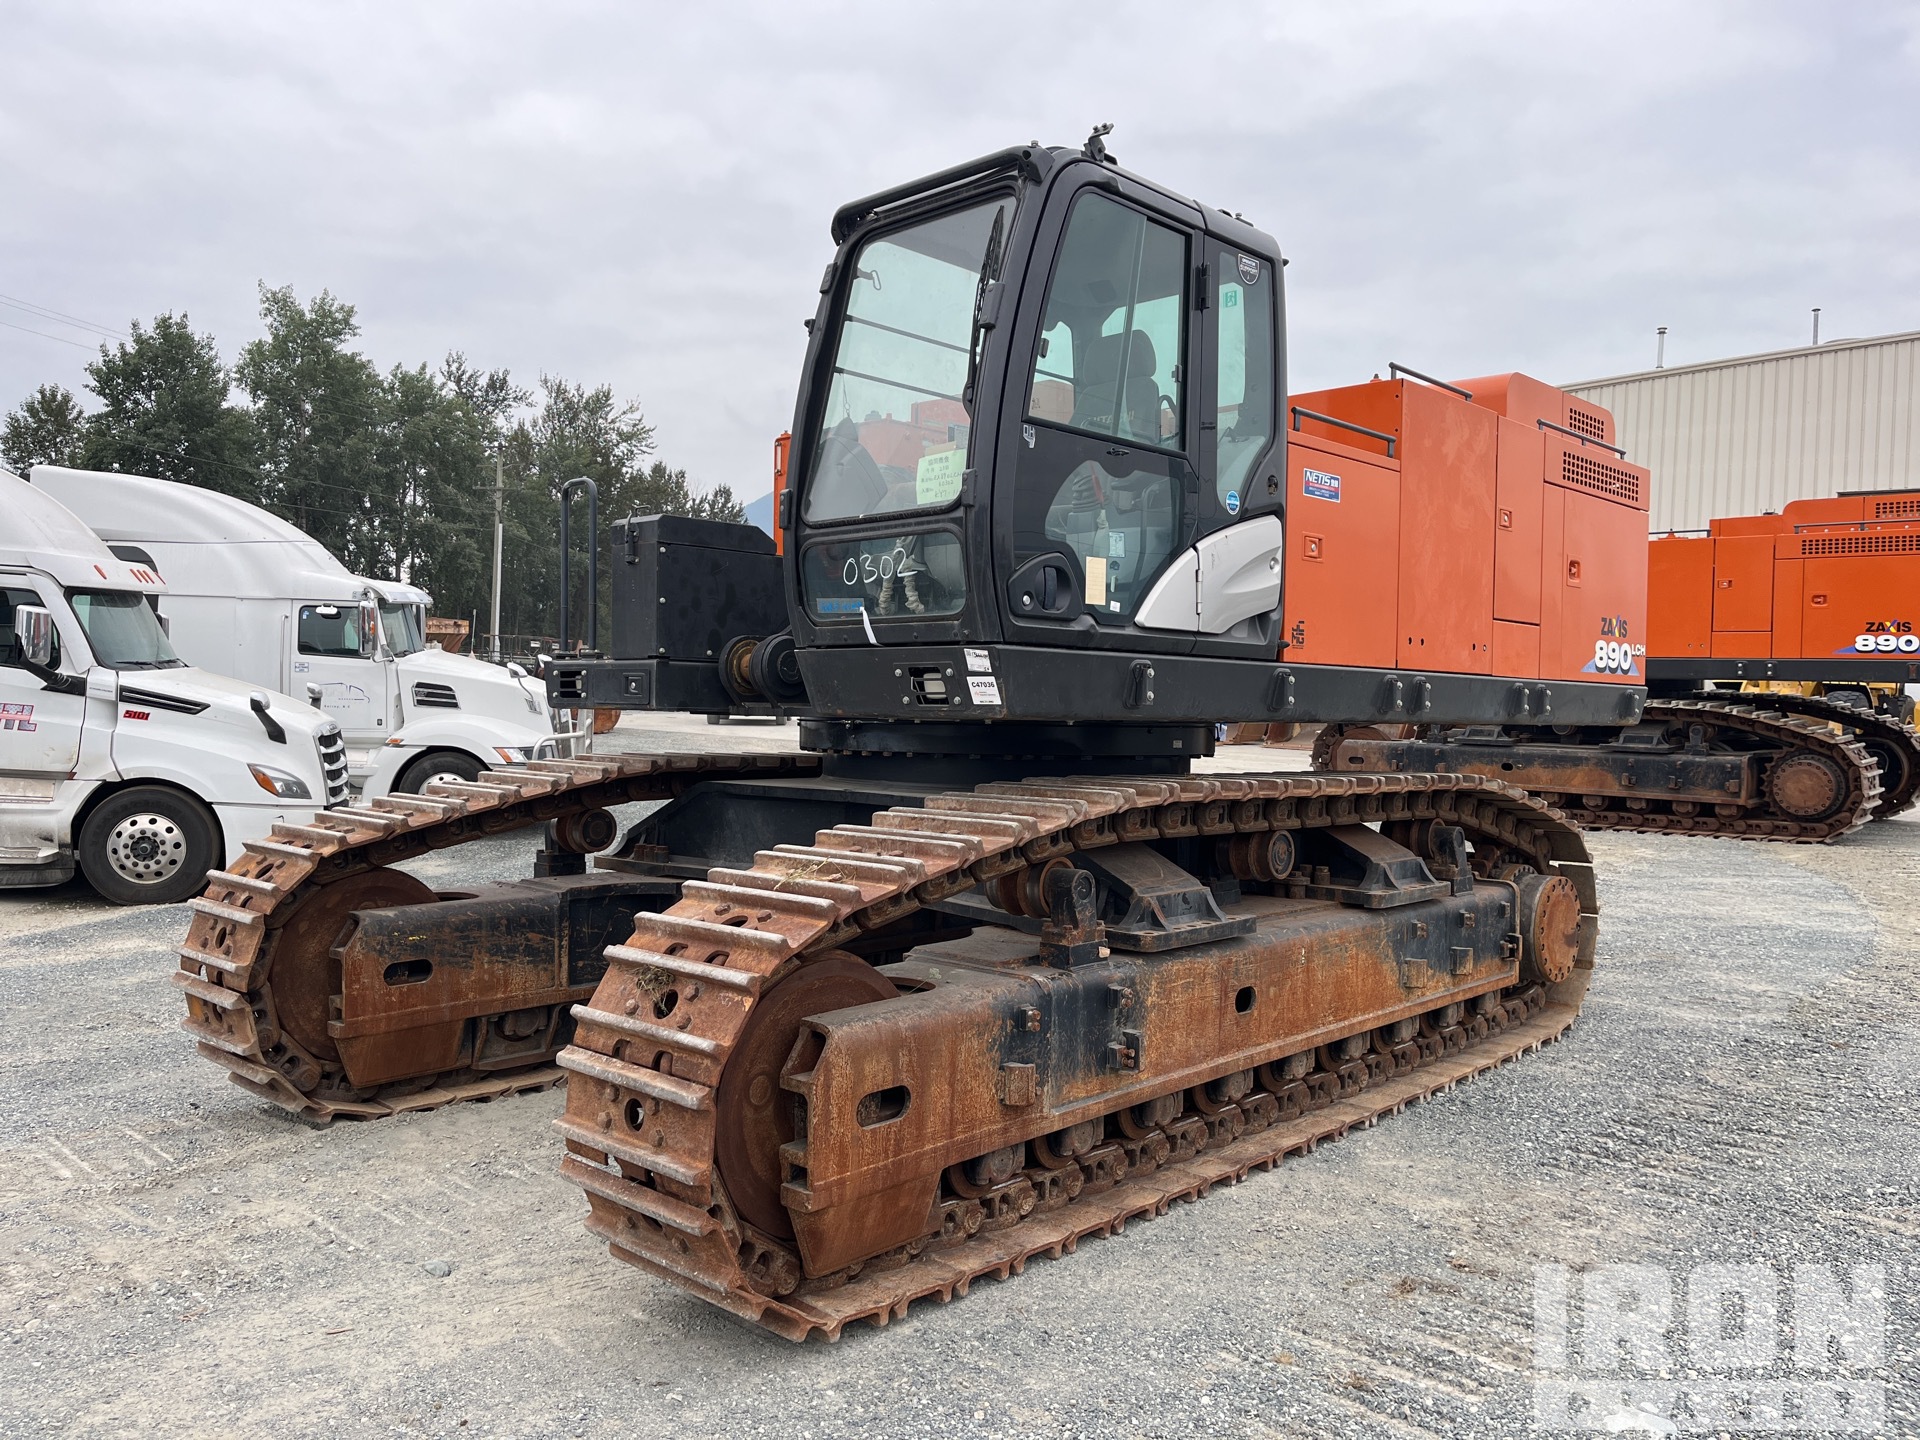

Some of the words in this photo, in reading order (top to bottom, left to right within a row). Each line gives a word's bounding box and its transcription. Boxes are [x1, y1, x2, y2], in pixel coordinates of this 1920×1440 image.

[1306, 471, 1330, 486] NETIS
[843, 548, 918, 585] 0302
[1601, 615, 1628, 638] ZAXIS
[1865, 620, 1912, 633] ZAXIS
[1854, 634, 1920, 654] 890
[1595, 640, 1632, 675] 890
[1631, 644, 1646, 657] LCH
[123, 710, 150, 721] 5101
